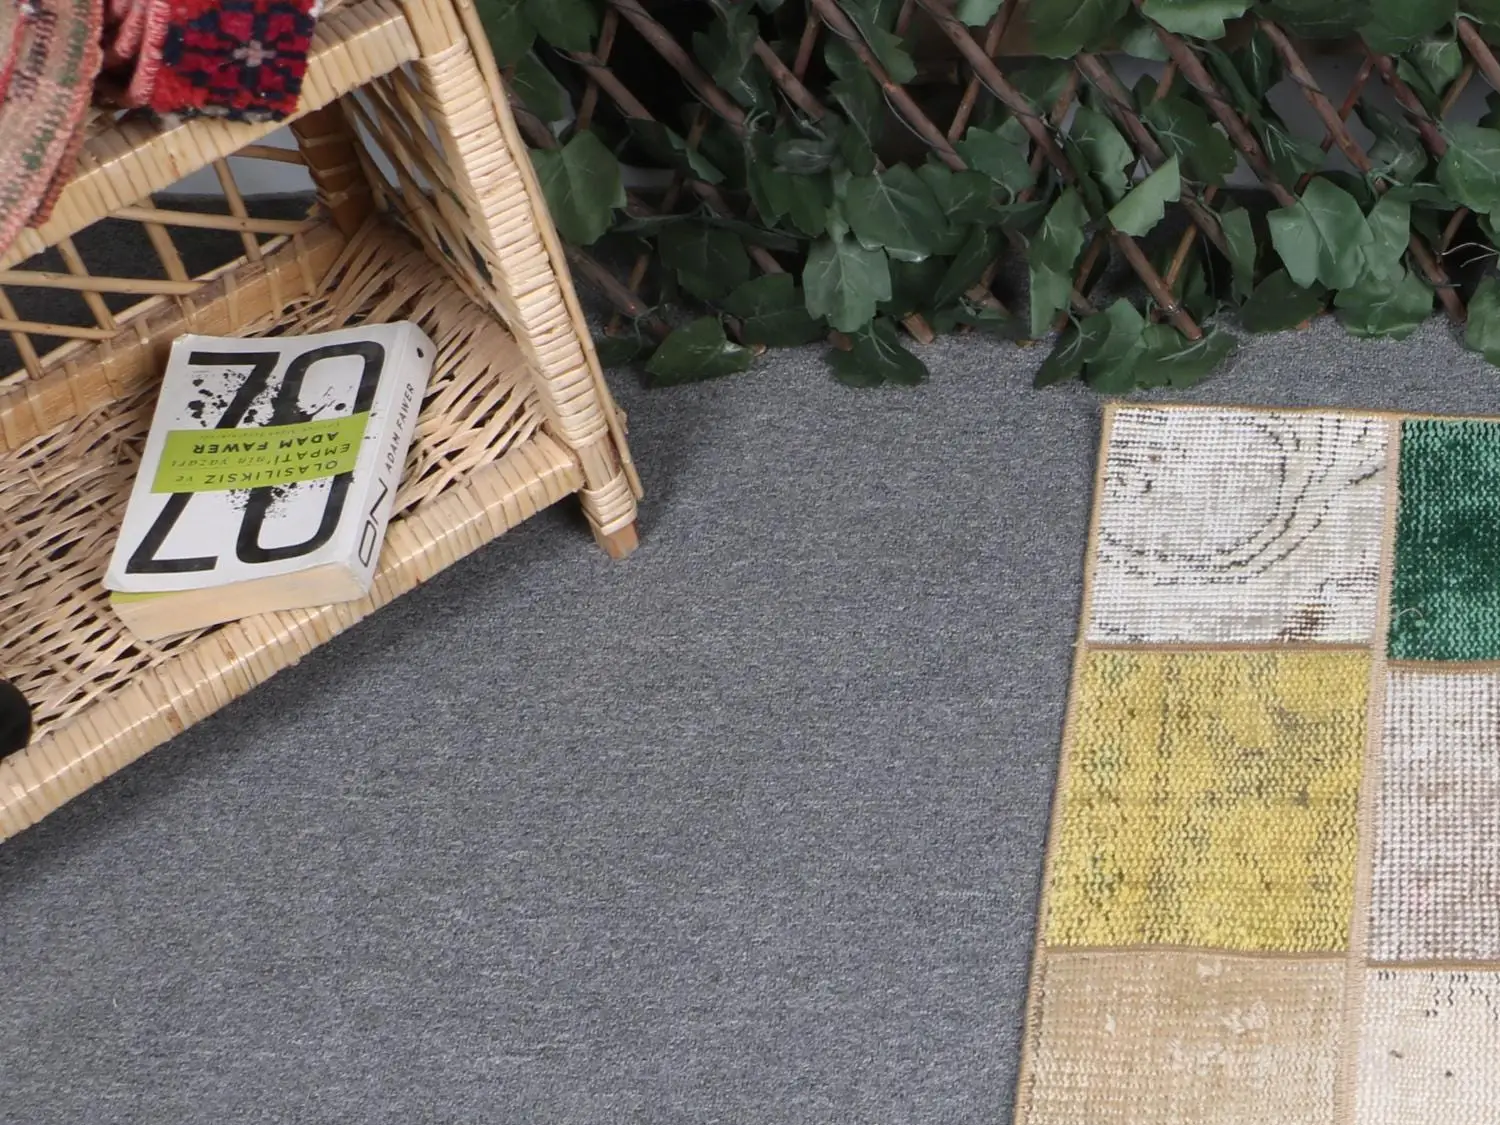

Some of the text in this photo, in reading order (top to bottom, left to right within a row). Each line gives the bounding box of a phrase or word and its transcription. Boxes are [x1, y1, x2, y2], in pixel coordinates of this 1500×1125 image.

[384, 433, 401, 475] ADAM
[396, 383, 415, 430] FAWER
[193, 431, 339, 454] ADAM FAWER
[204, 460, 338, 485] OLASILIKSIZ
